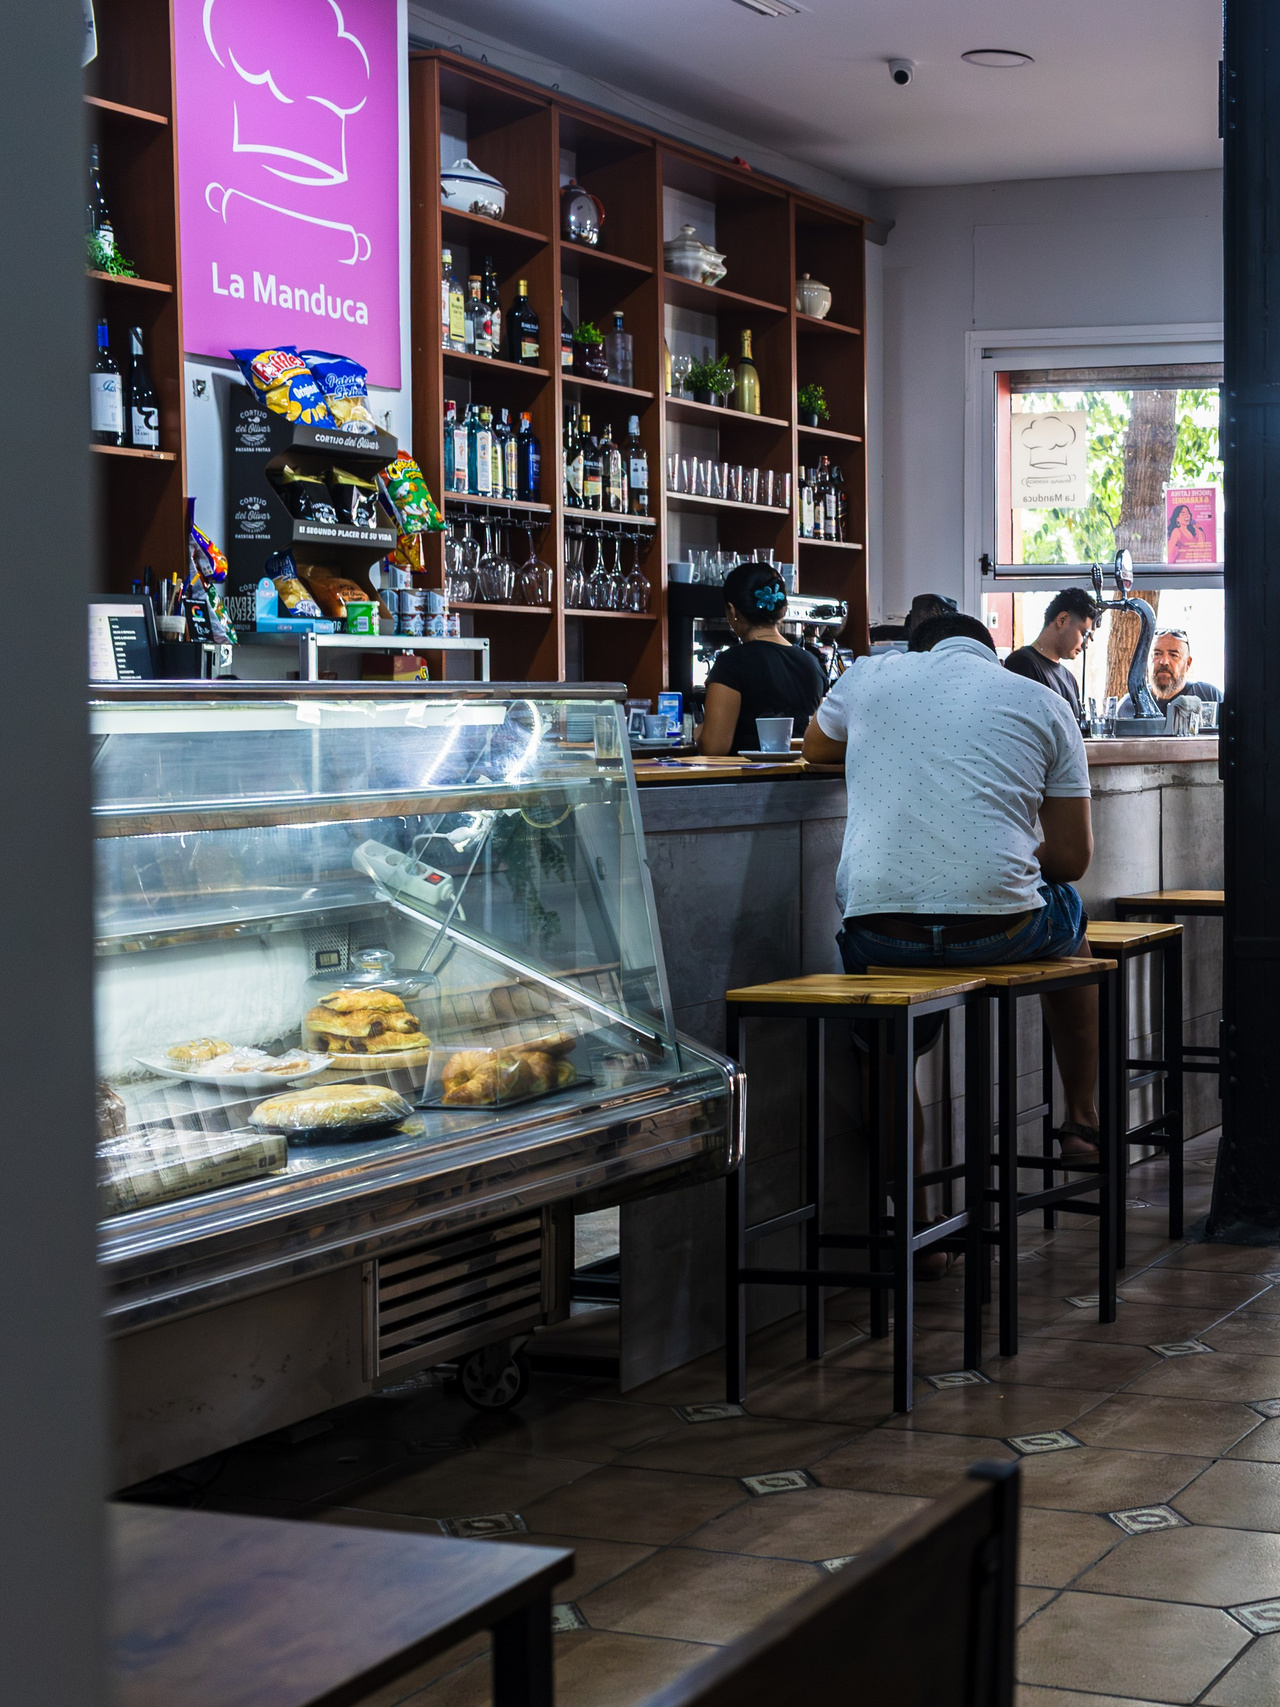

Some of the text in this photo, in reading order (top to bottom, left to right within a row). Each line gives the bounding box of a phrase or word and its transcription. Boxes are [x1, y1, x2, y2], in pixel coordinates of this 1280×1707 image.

[212, 262, 369, 325] La Manduca
[239, 409, 268, 419] CORTIJO
[235, 422, 271, 433] del Olivar
[315, 434, 380, 451] CORTIJO del Olivar
[239, 497, 267, 506] CORTIJO
[235, 510, 271, 520] del Olivar
[306, 527, 337, 537] SEGUNDO
[337, 529, 360, 539] PLACER
[361, 531, 369, 540] DE
[369, 531, 378, 540] SU
[378, 532, 392, 542] VIDA
